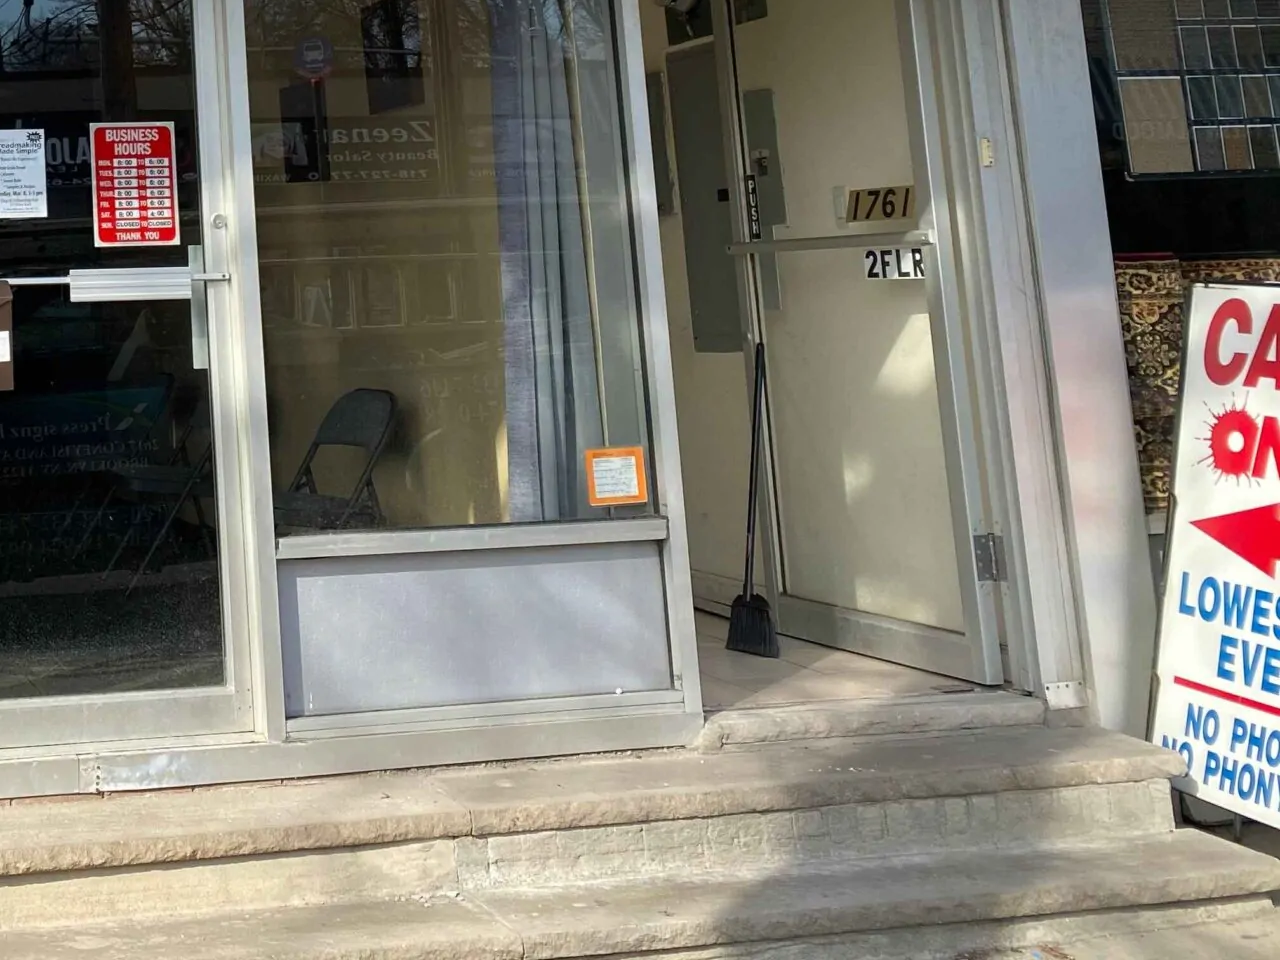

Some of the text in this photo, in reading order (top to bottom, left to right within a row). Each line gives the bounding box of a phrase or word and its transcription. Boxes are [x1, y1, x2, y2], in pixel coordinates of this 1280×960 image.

[105, 129, 159, 142] BUSINESS
[114, 142, 152, 155] HOURS
[747, 179, 761, 235] PUSH
[853, 188, 910, 220] 1761
[116, 232, 160, 241] THANK YOU
[865, 248, 925, 279] 2FLR
[1178, 571, 1280, 640] LOWE
[1217, 634, 1280, 696] EVE
[1185, 702, 1220, 746] NO
[1203, 750, 1280, 812] PHON
